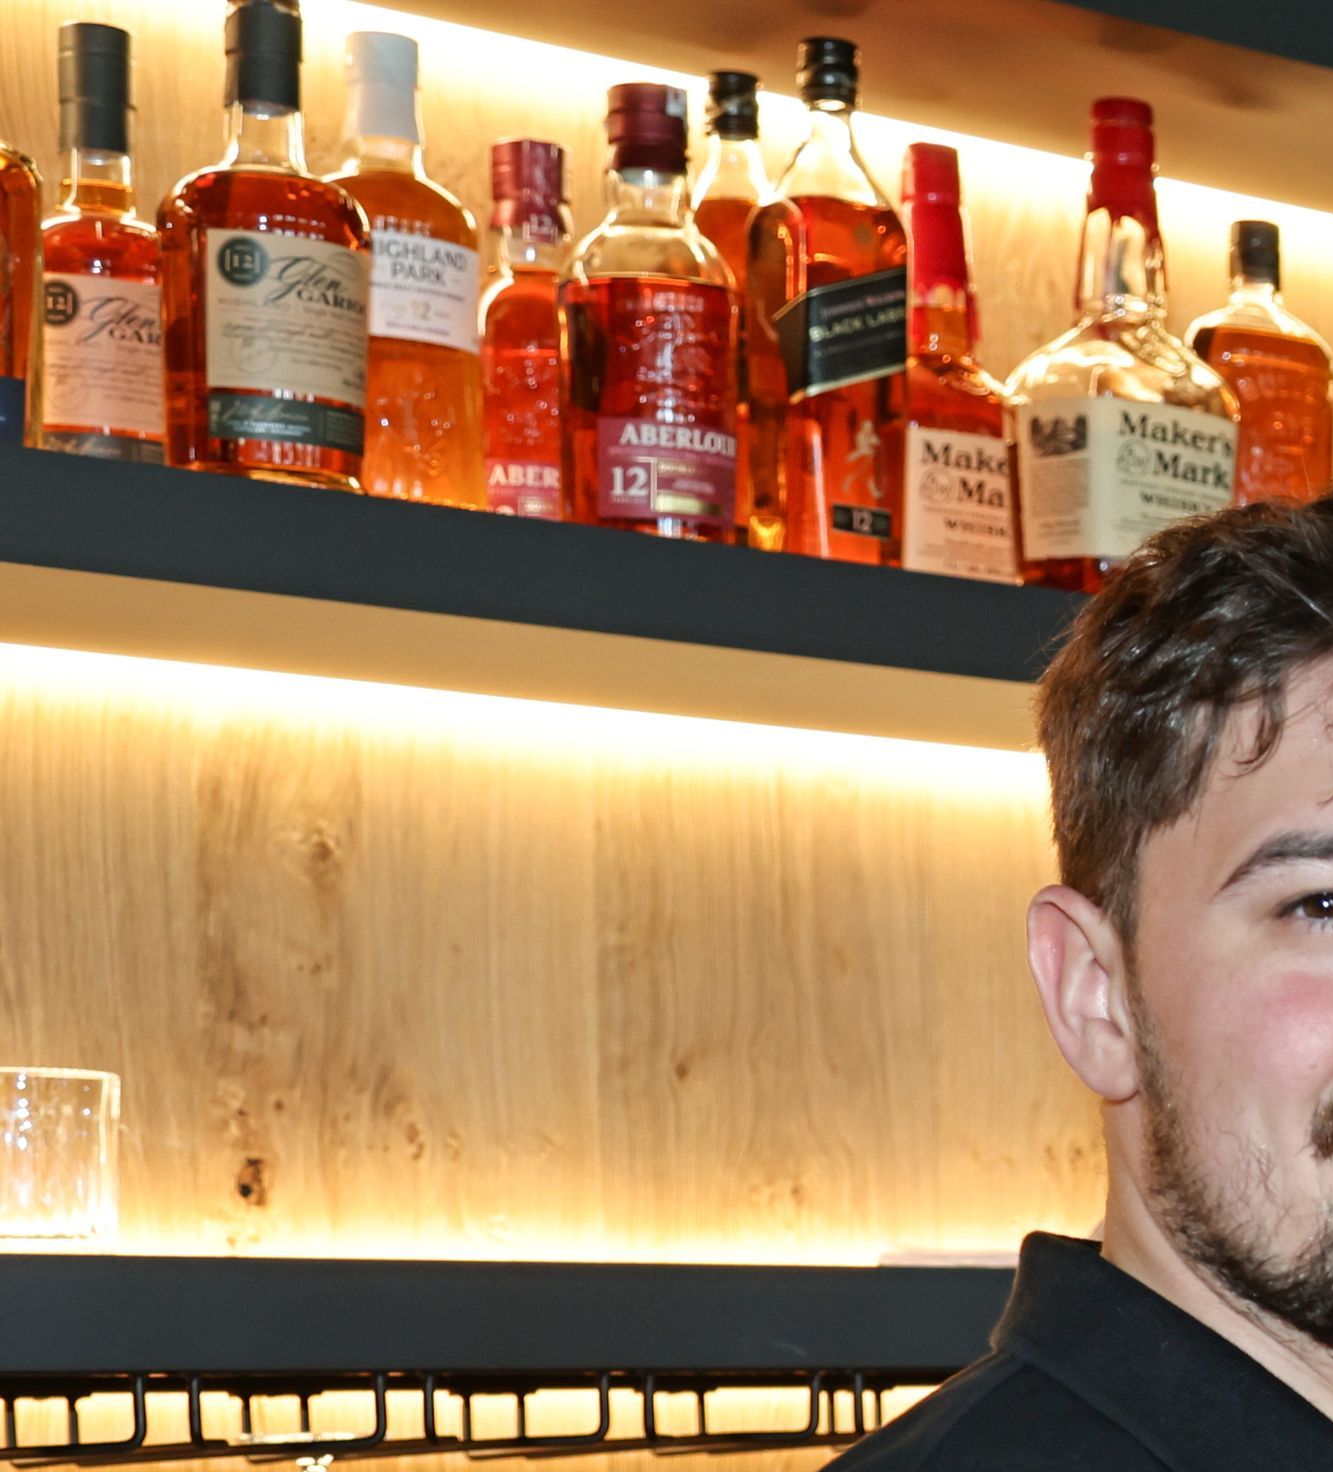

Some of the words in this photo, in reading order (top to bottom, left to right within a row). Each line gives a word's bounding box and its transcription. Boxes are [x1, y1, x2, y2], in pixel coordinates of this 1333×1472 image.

[391, 261, 447, 287] PARK
[1118, 408, 1233, 458] Maker's
[488, 464, 561, 489] ABER
[612, 465, 650, 498] 12
[1152, 450, 1230, 490] Mark
